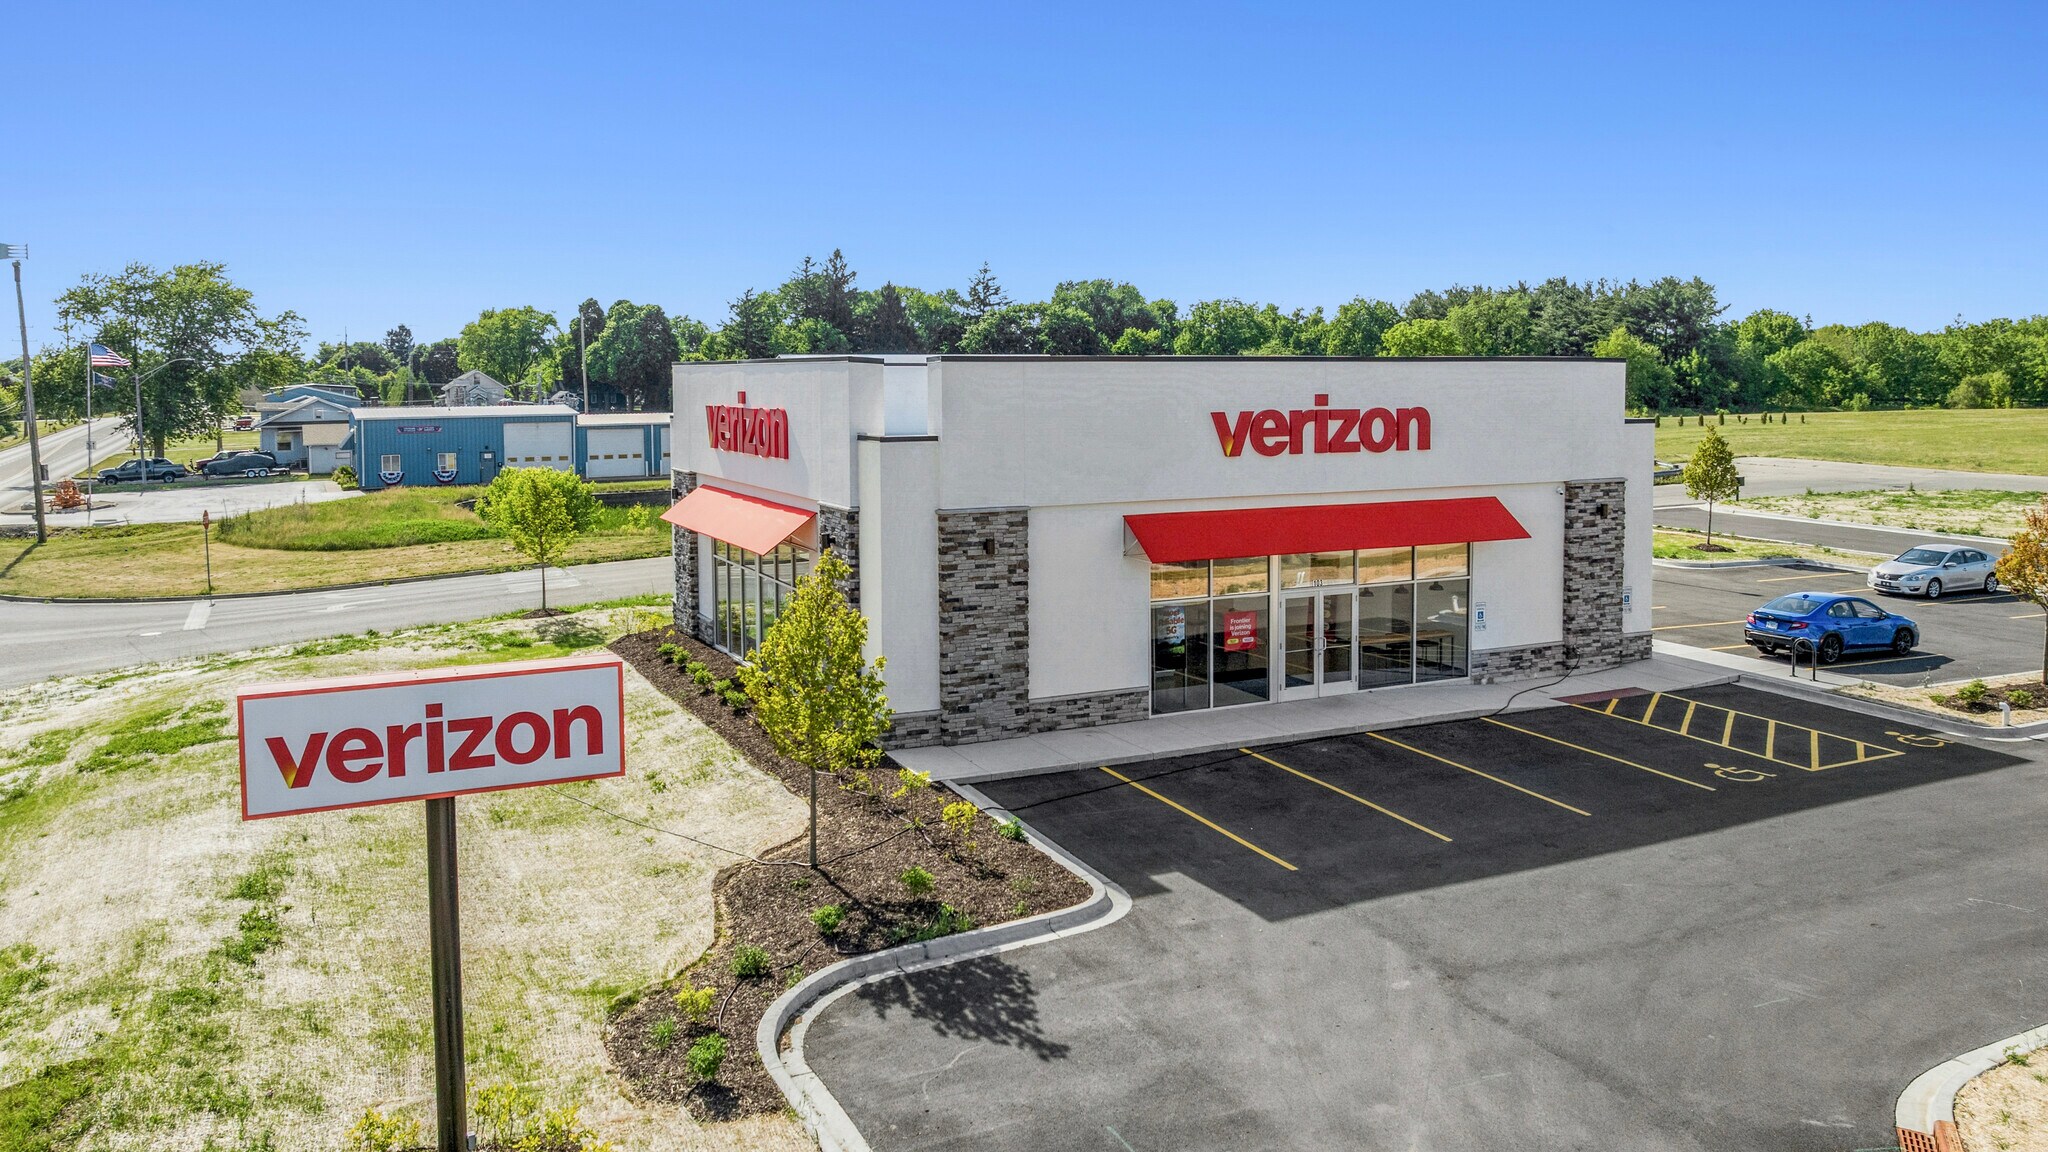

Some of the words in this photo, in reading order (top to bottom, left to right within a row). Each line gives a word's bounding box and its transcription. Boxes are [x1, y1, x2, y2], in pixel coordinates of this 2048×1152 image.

[706, 391, 789, 459] verizon
[1211, 394, 1431, 457] verizon
[1166, 626, 1177, 635] 5G
[265, 703, 604, 789] verizon
